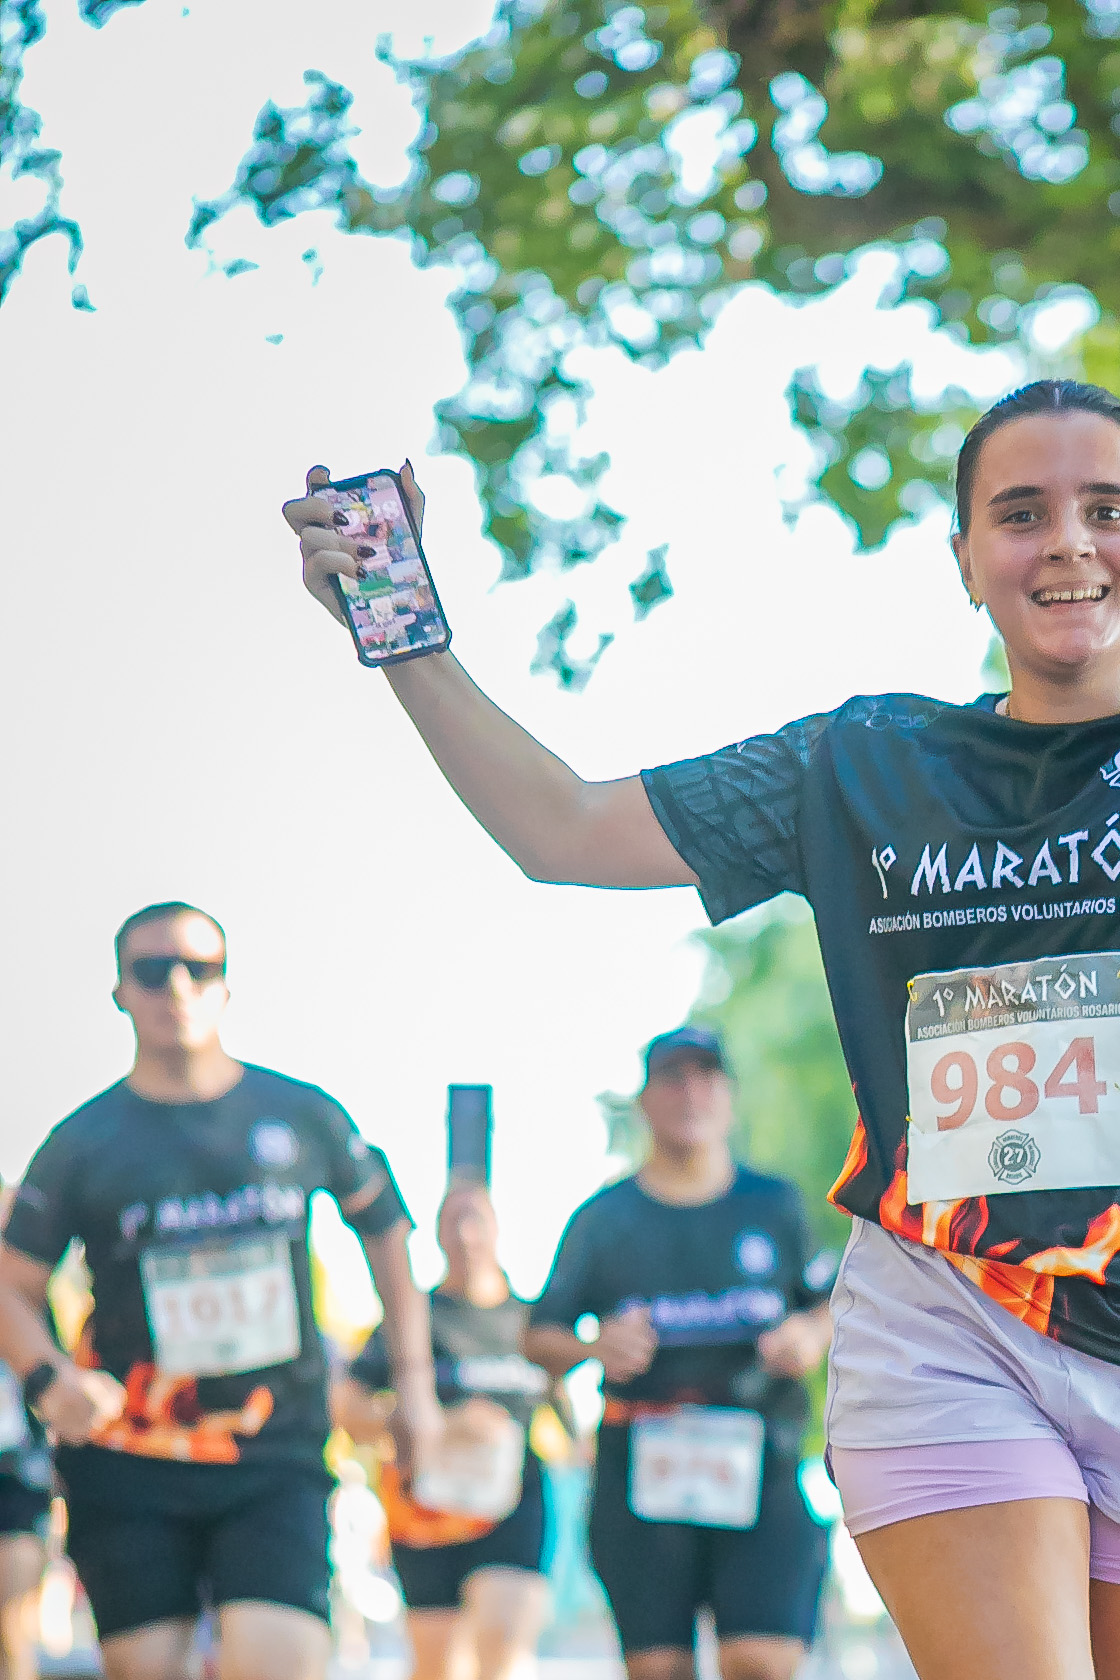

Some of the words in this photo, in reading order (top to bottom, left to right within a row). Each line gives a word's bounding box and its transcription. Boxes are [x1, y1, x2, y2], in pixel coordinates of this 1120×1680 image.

[922, 904, 1008, 929] BOMBEROS
[1010, 899, 1116, 921] VOLUNTARIOS
[964, 963, 1098, 1012] MARATÓN
[967, 1013, 1015, 1031] BOMBEROS
[1016, 1005, 1080, 1023] VOLUNTARIOS
[930, 1036, 1107, 1131] 984
[1003, 1146, 1024, 1166] 27
